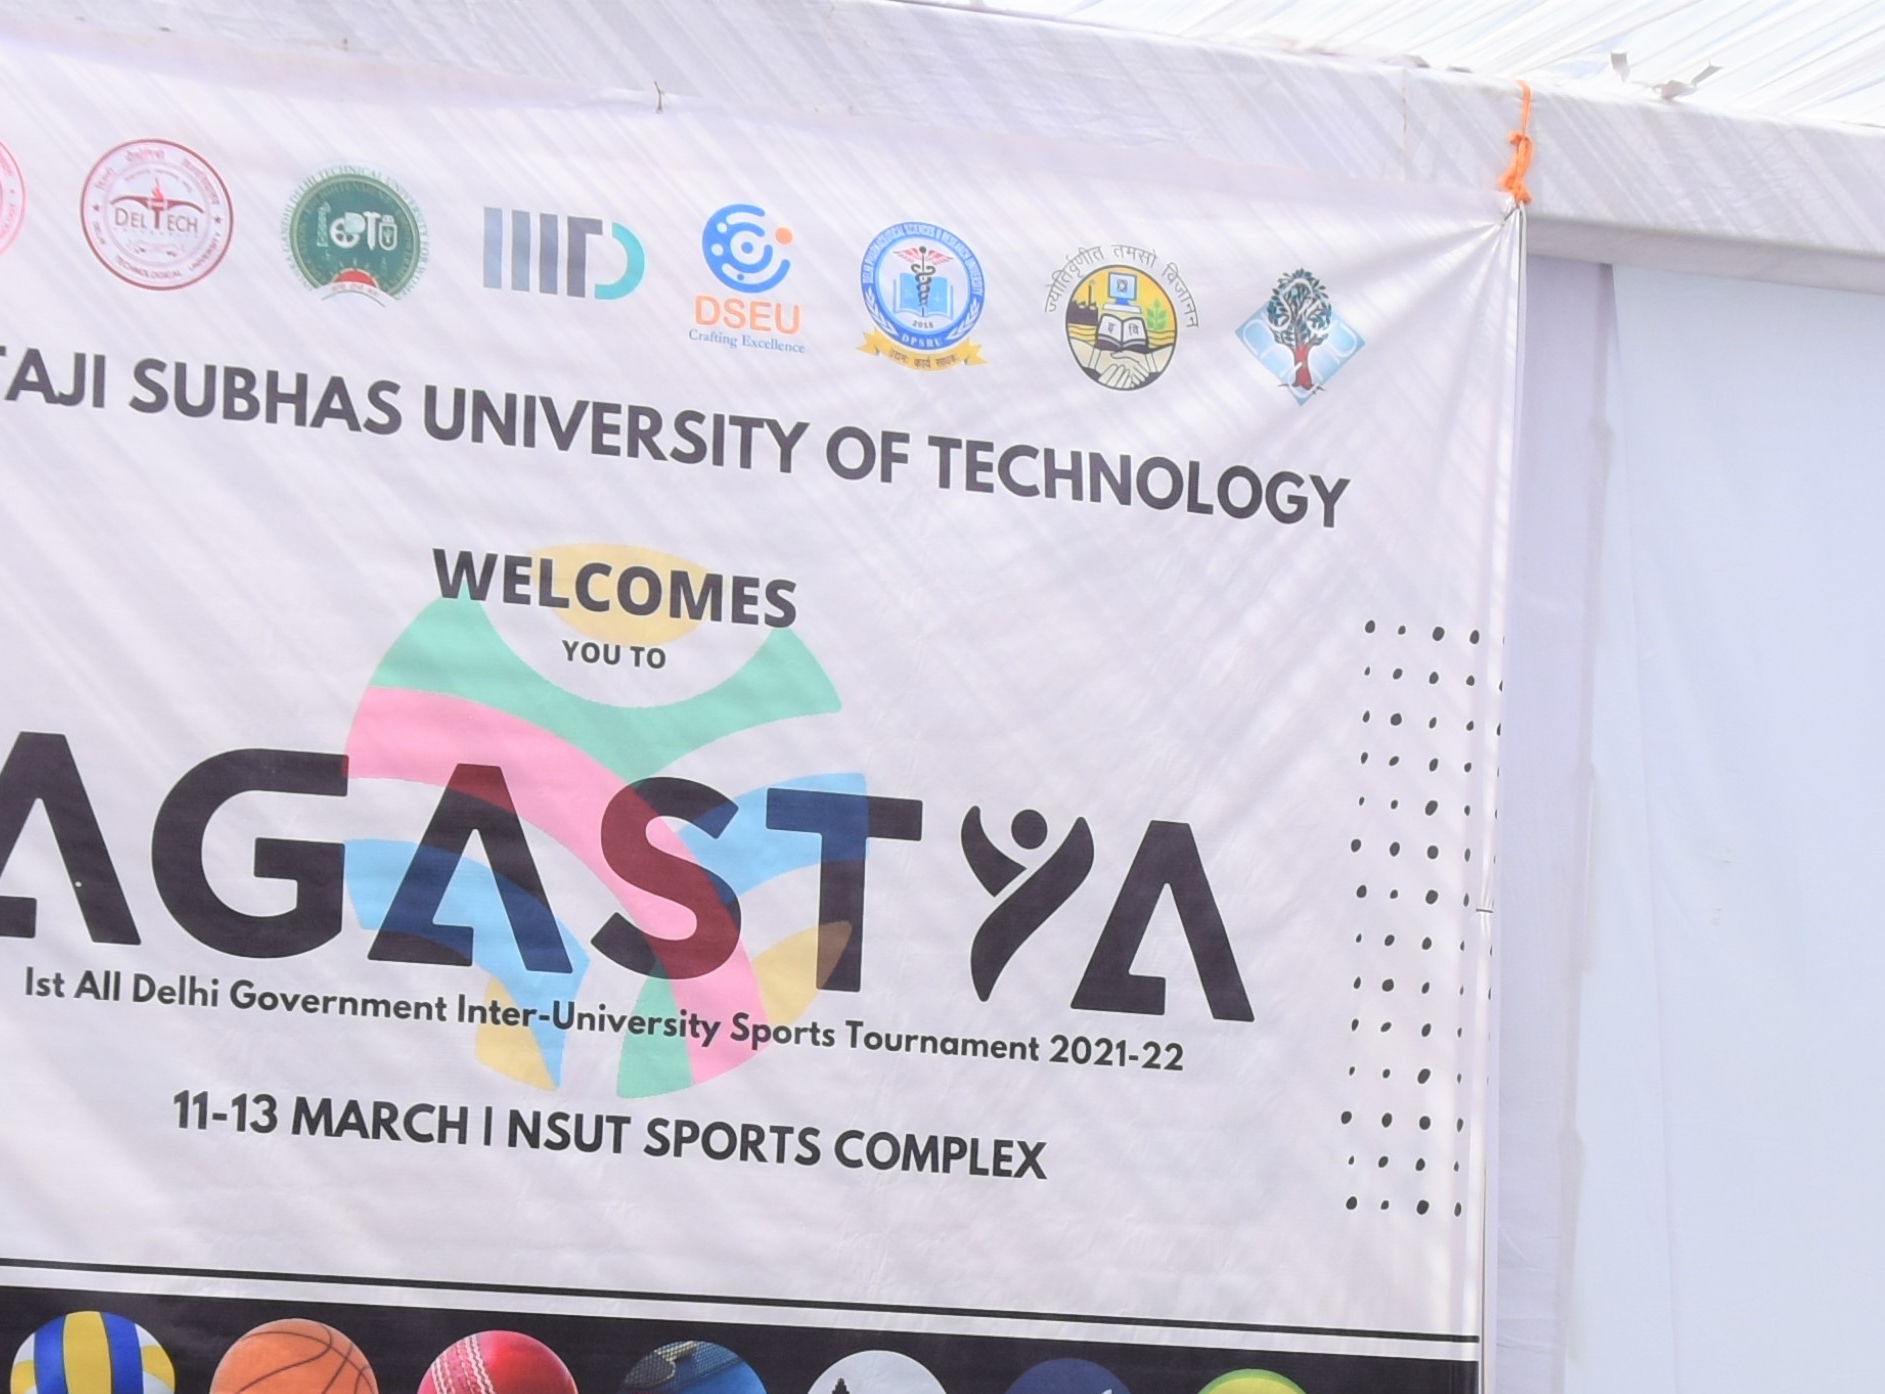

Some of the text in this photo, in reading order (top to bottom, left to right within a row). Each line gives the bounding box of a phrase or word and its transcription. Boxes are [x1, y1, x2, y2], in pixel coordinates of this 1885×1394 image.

[1111, 244, 1158, 268] तमसो
[688, 328, 806, 354] Crafting Excellence
[694, 294, 801, 335] DSEU
[128, 358, 402, 435] SUBHAS
[424, 385, 809, 474] UNIVERSITY
[825, 425, 910, 484] OF
[927, 435, 1350, 528] TECHNOLOGY
[432, 548, 797, 628] WELCOMES
[562, 640, 666, 669] YOU TO
[74, 970, 121, 1002] All
[132, 973, 220, 1008] Delhi
[229, 979, 448, 1023] Government
[457, 994, 722, 1049] Inter-University
[729, 1011, 836, 1051] Sports
[845, 1020, 1041, 1062] Tournament
[1048, 1034, 1184, 1072] 2021-22
[173, 1089, 279, 1134] 11-13
[291, 1096, 469, 1145] MARCH
[508, 1109, 631, 1154] NSUT
[643, 1117, 821, 1168] SPORTS
[833, 1129, 1048, 1181] COMPLEX
